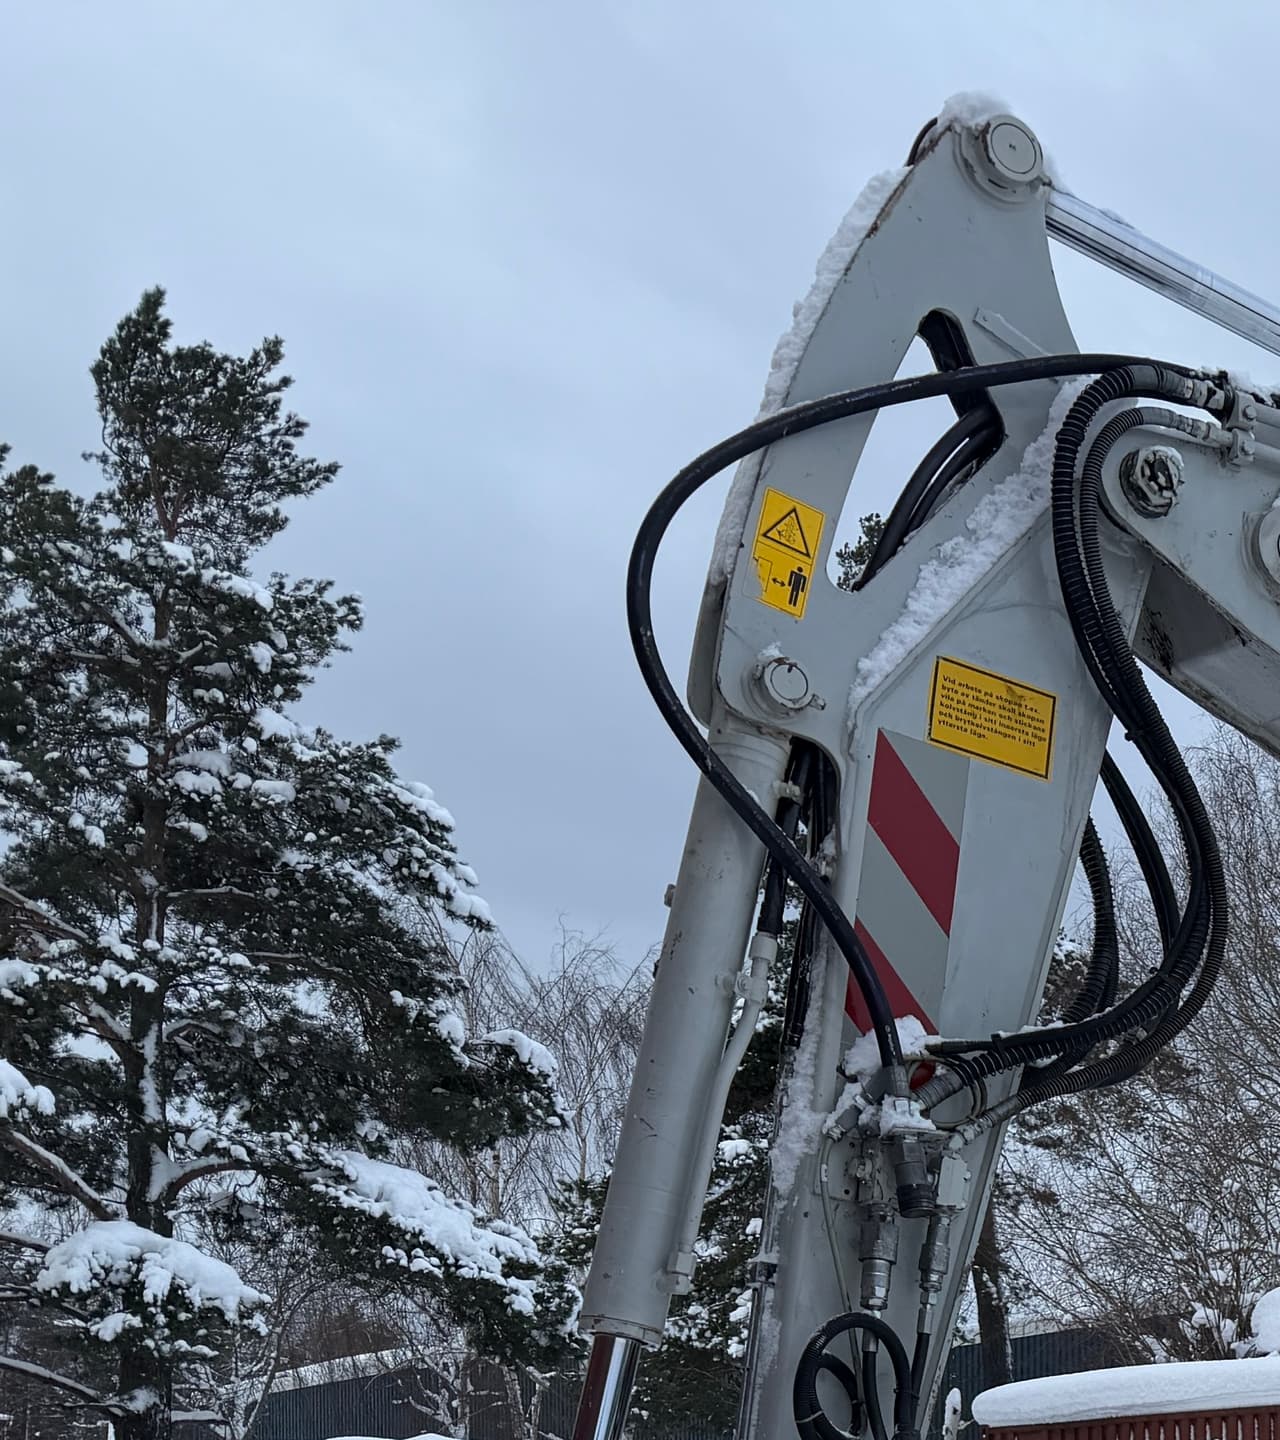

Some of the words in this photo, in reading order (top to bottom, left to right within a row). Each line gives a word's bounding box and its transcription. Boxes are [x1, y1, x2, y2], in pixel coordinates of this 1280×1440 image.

[943, 675, 956, 685] Vid
[958, 681, 982, 694] arbete
[984, 690, 993, 699] på
[940, 693, 955, 702] vila
[956, 698, 966, 707] på
[967, 702, 996, 717] marken
[998, 712, 1013, 722] och
[941, 684, 959, 696] byte
[971, 695, 996, 707] tänder
[998, 702, 1016, 715] skall
[1017, 710, 1045, 726] skopan
[937, 718, 968, 733] yttersta
[970, 727, 988, 740] läge.
[938, 710, 953, 720] och
[1023, 738, 1036, 747] sitt
[984, 715, 997, 726] sitt
[999, 720, 1029, 736] innersta
[1031, 731, 1047, 743] läge
